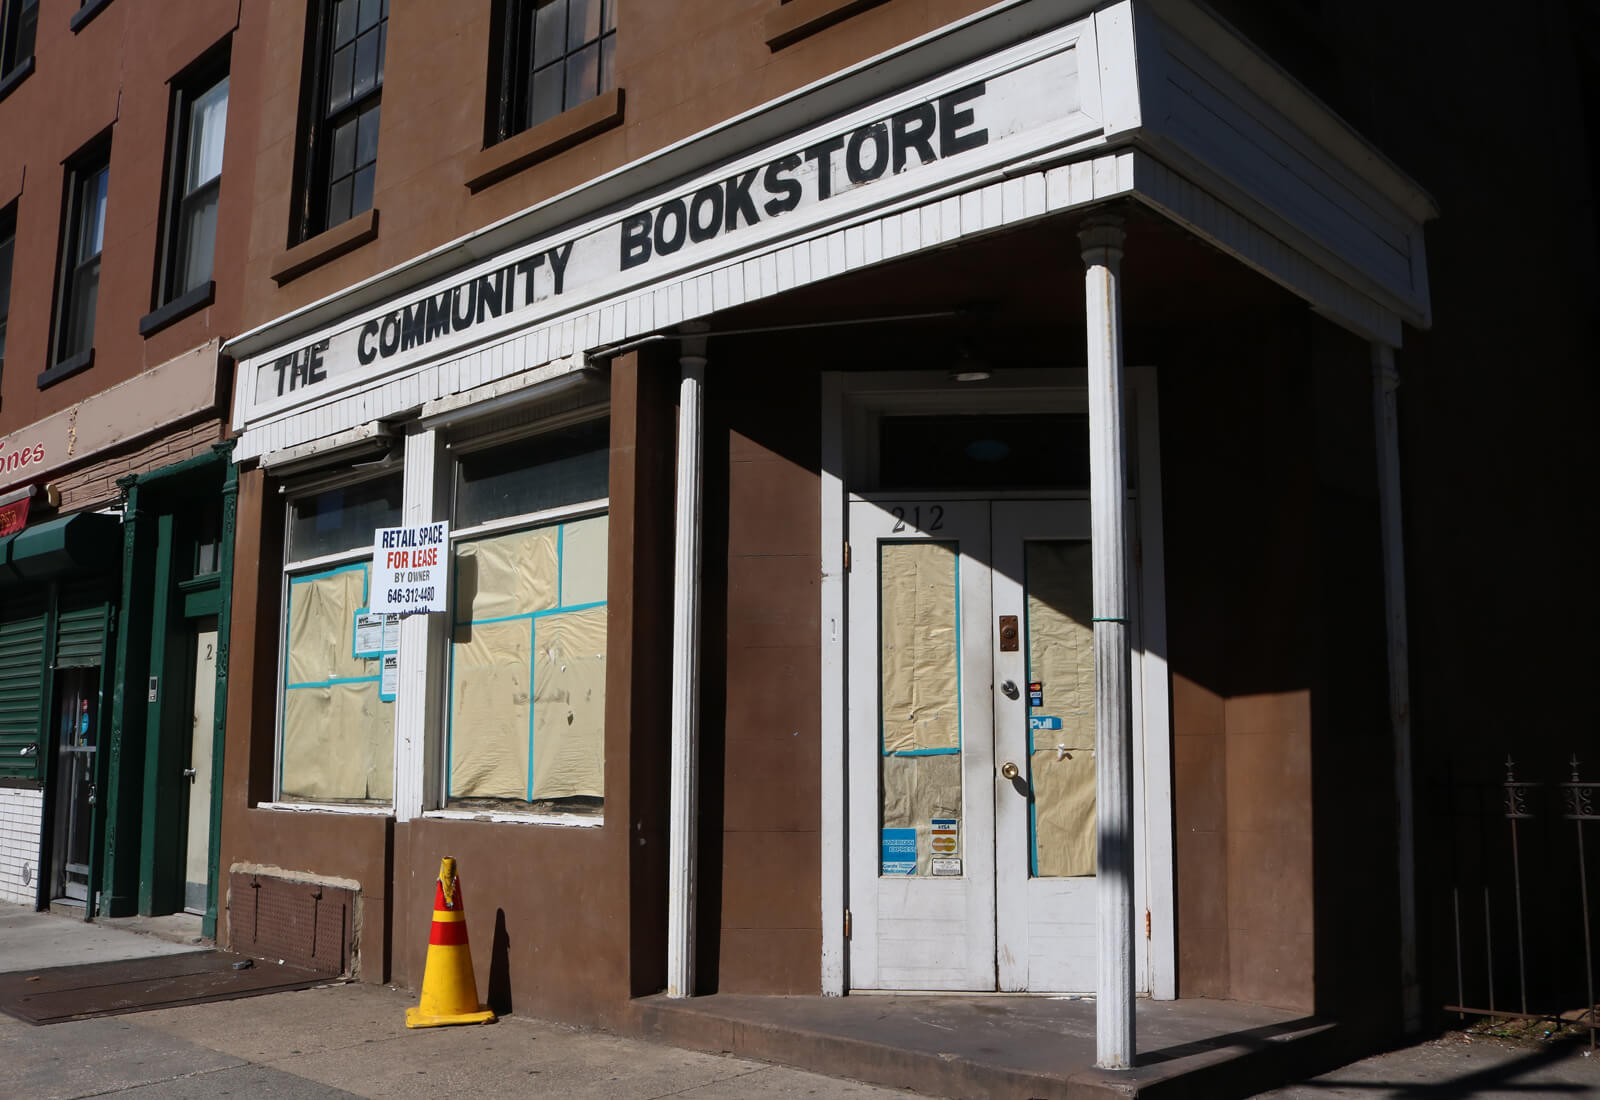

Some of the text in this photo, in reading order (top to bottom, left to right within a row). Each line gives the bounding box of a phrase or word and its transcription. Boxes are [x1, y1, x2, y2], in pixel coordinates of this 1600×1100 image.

[273, 81, 989, 397] THE COMMUNITY BOOKSTORE
[892, 505, 944, 534] 212
[382, 524, 443, 549] RETAIL SPACE
[387, 547, 438, 569] FOR LEASE
[394, 570, 430, 583] BY OWNER
[387, 586, 435, 603] 646-312-4480
[358, 616, 369, 624] NYC
[385, 657, 397, 665] NYC
[1030, 718, 1052, 728] Pull
